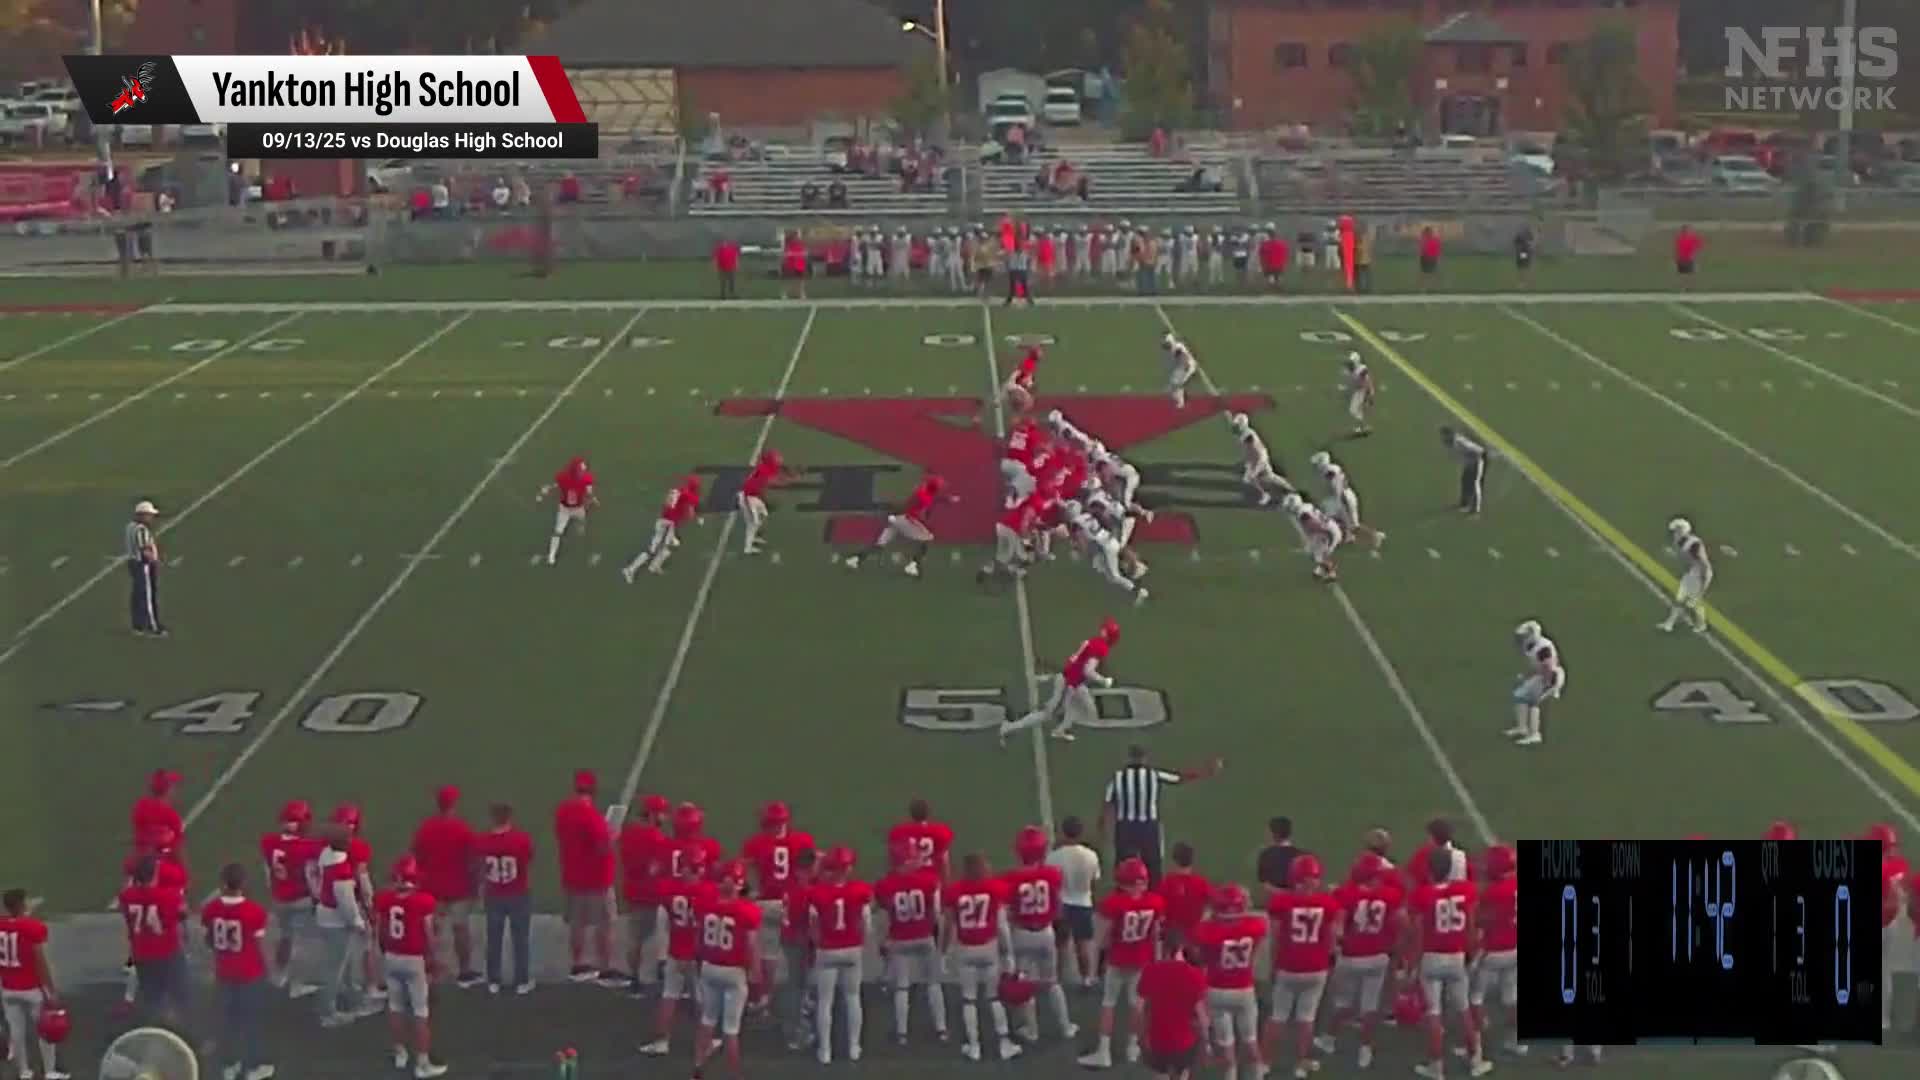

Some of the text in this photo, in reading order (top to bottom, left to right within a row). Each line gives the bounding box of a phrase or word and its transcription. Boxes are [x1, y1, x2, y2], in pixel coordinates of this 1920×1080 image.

[902, 685, 1168, 730] 50
[1653, 678, 1920, 722] 40
[773, 846, 790, 881] 9
[128, 904, 163, 935] 74
[389, 905, 405, 940] 6
[834, 897, 847, 931] 1
[958, 893, 989, 930] 27
[1122, 909, 1155, 942] 87
[1290, 908, 1324, 944] 57
[1435, 895, 1464, 933] 85
[703, 913, 735, 951] 86
